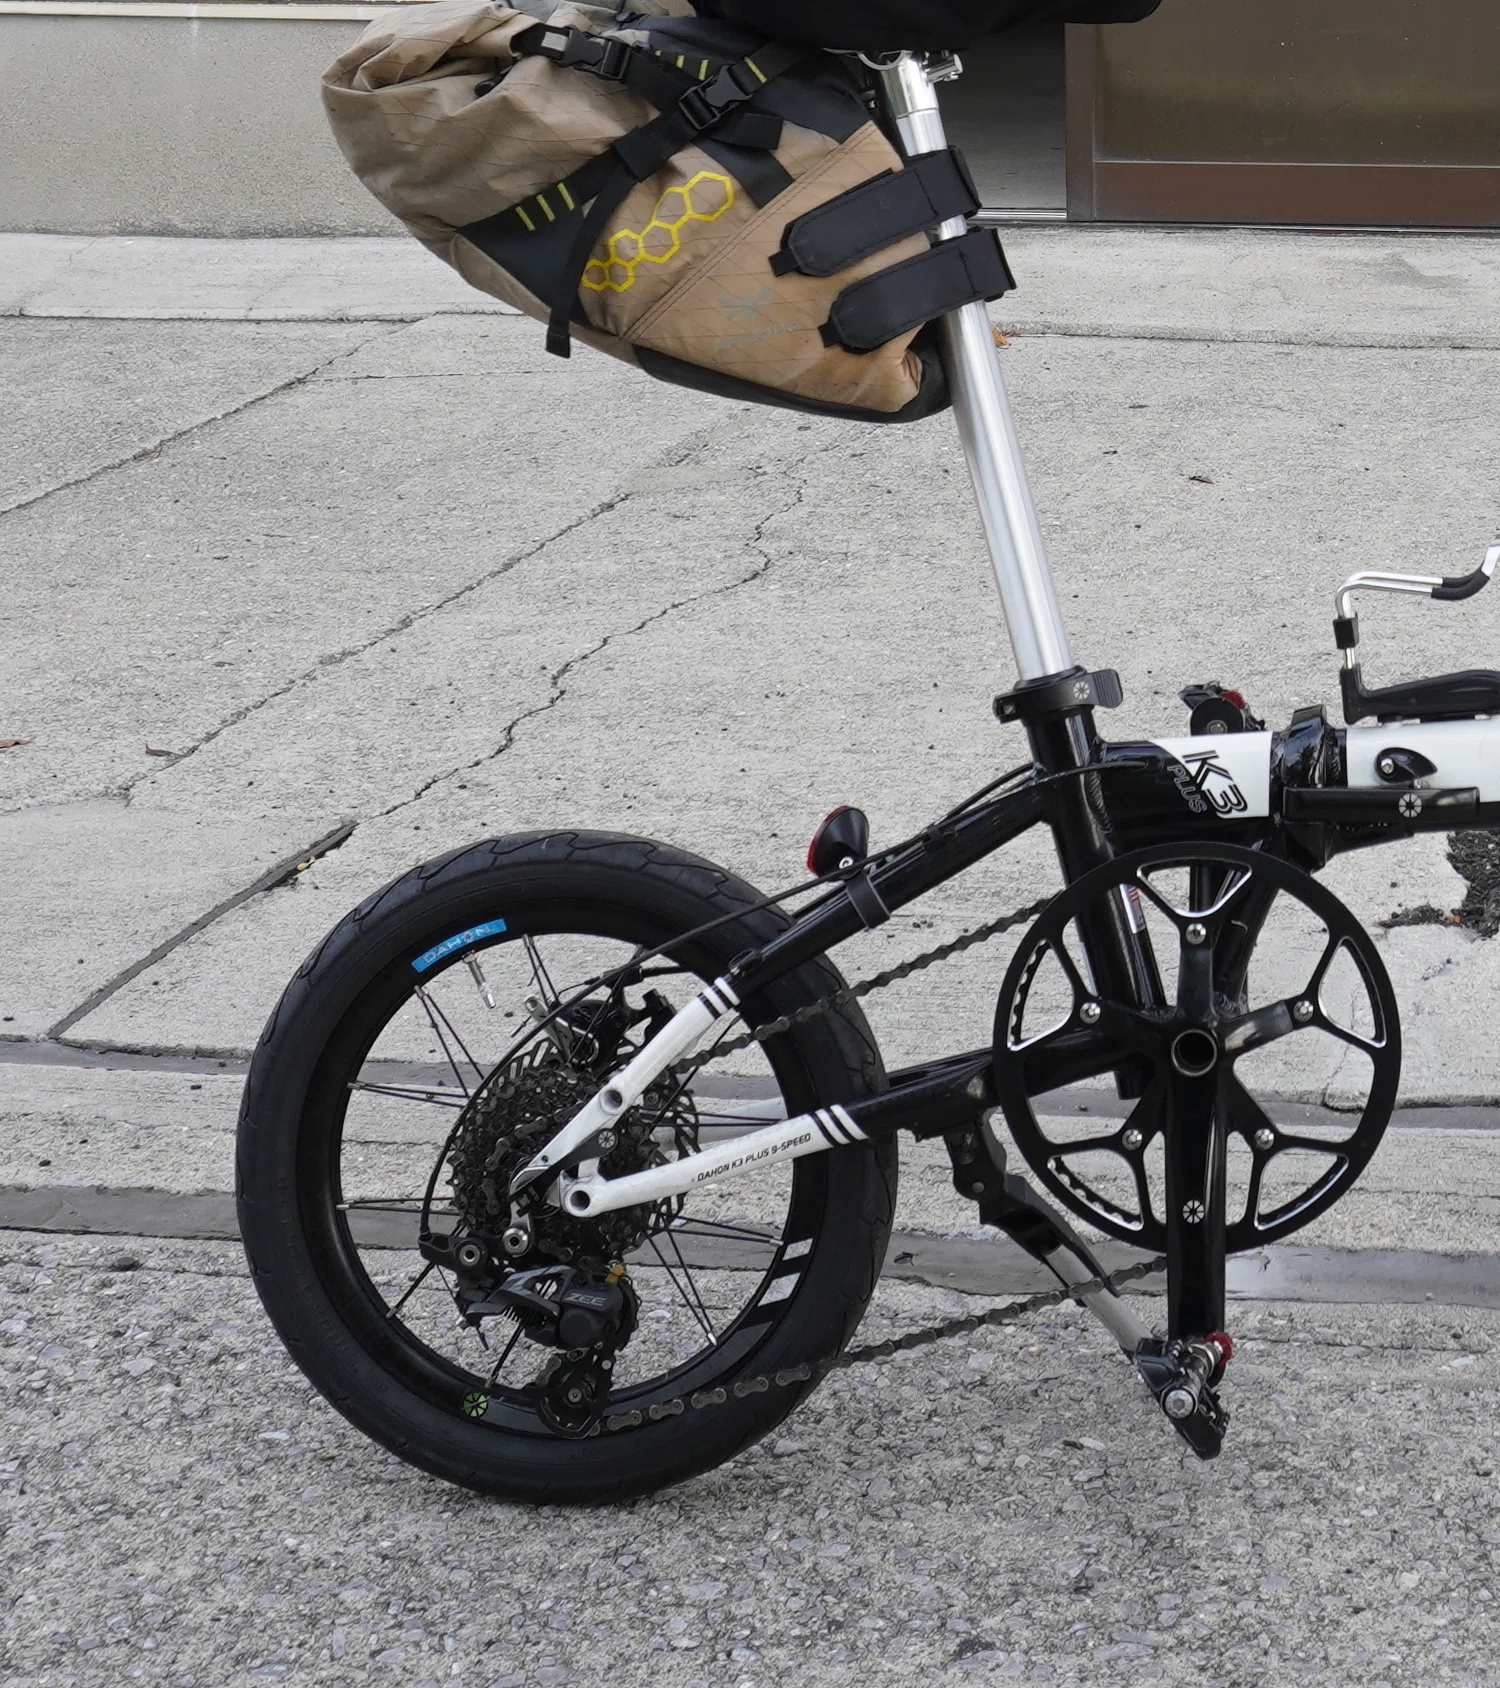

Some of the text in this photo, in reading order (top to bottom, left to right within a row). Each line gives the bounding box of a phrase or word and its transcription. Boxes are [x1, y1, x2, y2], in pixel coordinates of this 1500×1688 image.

[1167, 764, 1208, 814] PLUS
[1181, 749, 1249, 816] K3
[422, 926, 491, 964] DAHON
[697, 1132, 811, 1182] DAHON K3 PLUS 9-SPEED
[565, 1292, 607, 1307] ZEE
